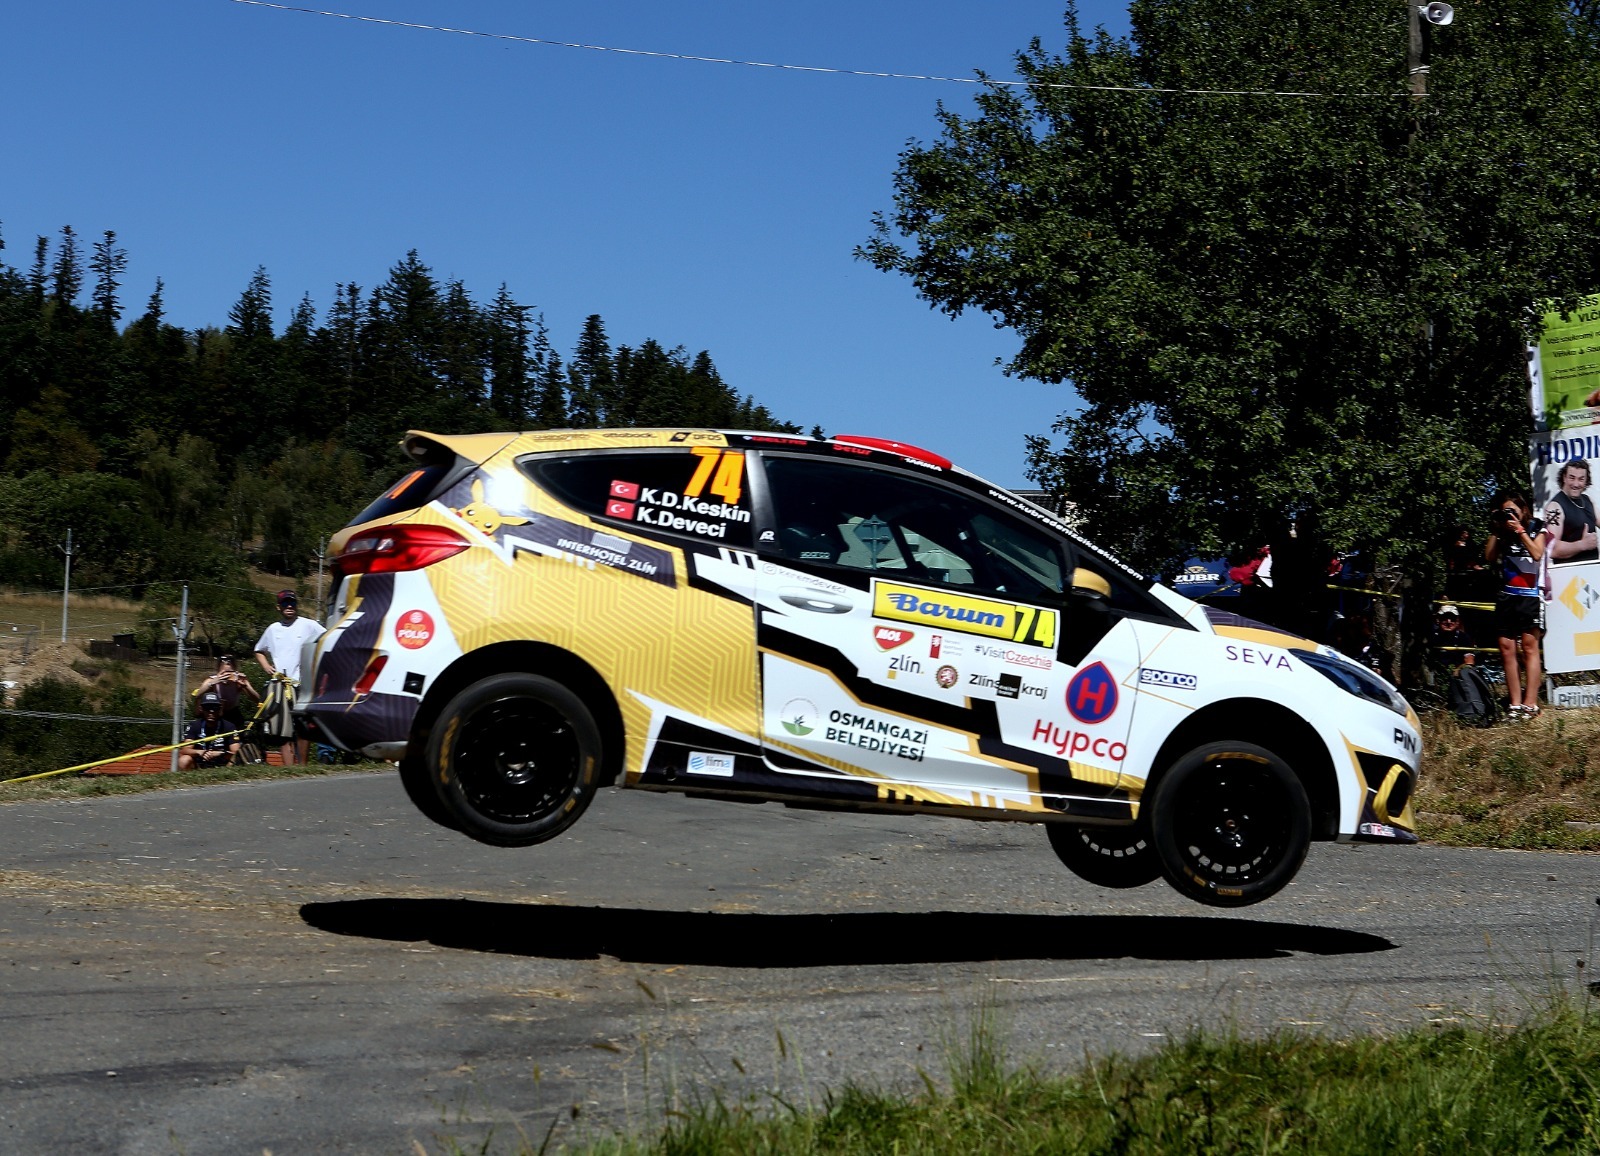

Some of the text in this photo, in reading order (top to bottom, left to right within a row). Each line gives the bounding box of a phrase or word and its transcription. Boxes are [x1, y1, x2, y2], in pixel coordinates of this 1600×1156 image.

[1577, 310, 1600, 322] VLČ
[693, 433, 722, 441] DFDS
[683, 446, 745, 505] 74
[640, 487, 750, 523] K.D.Keskin
[636, 506, 727, 538] K.Deveci
[557, 538, 657, 575] INTERHOTEL ZLÍN
[887, 592, 1005, 628] Barum
[398, 630, 430, 640] POLIO
[876, 628, 902, 642] MOL
[1013, 605, 1056, 648] 74
[974, 644, 1053, 668] #VisitCzechia
[1226, 645, 1294, 672] SEVA
[1021, 682, 1048, 700] kraj
[1141, 669, 1197, 689] sparco
[829, 710, 929, 745] OSMANGAZİ
[1032, 719, 1127, 761] Hypco
[825, 727, 925, 762] BELEDİYESİ
